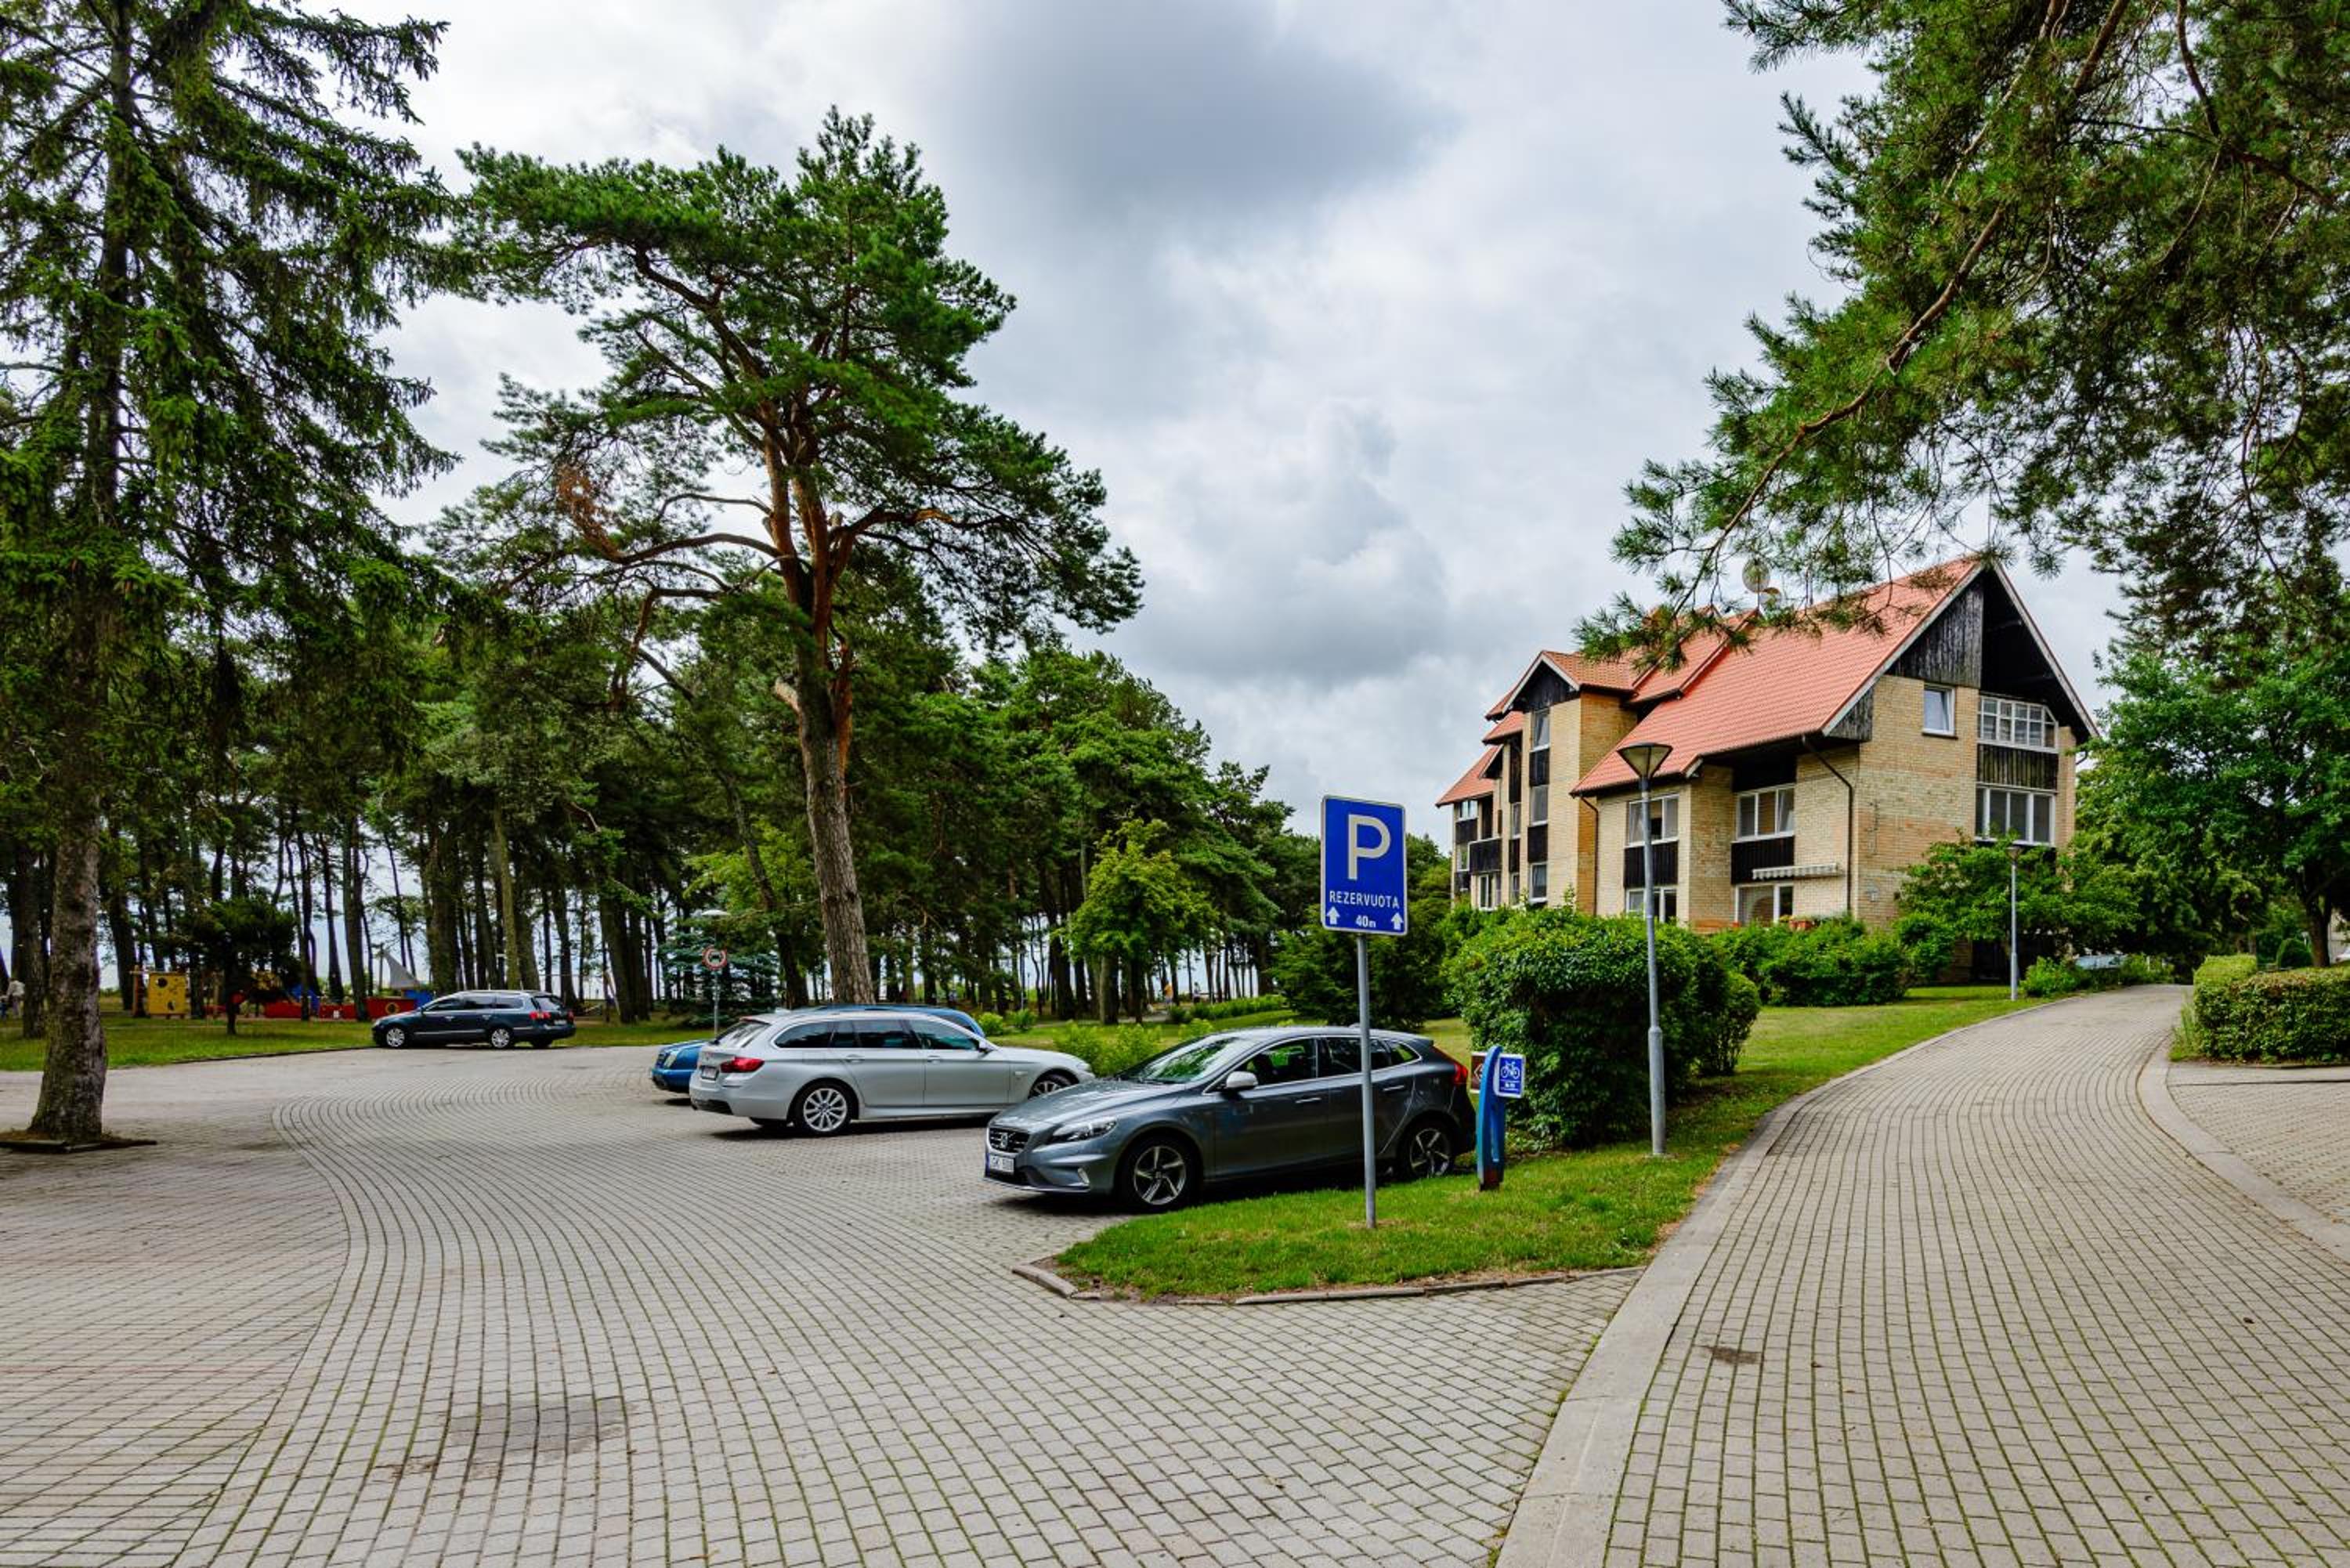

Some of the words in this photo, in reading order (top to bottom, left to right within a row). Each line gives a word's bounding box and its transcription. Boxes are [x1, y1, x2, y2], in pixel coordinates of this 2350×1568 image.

[1347, 814, 1391, 880] P
[1329, 891, 1400, 909] REZERVUOTA
[1355, 915, 1376, 928] 40m
